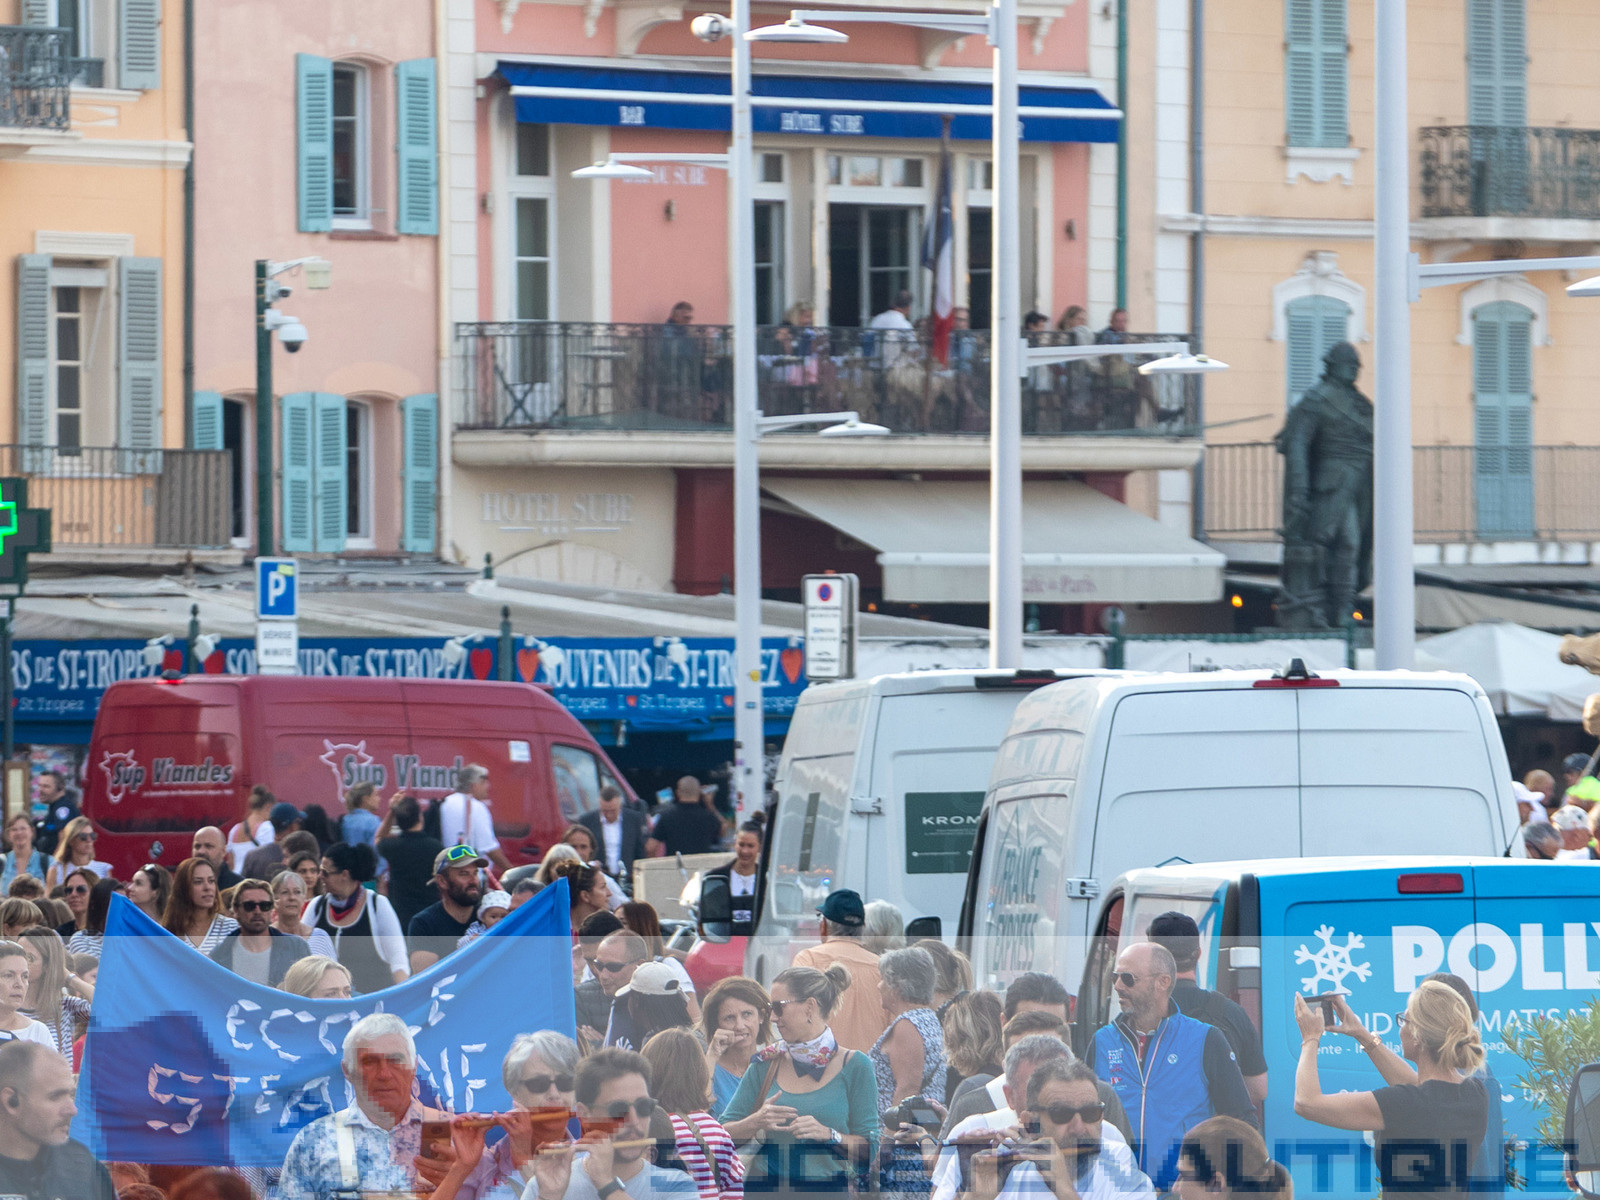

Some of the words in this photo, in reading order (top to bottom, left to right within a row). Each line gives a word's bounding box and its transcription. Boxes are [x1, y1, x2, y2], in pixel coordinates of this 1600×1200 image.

[619, 105, 645, 125] BAR
[571, 492, 634, 523] SUBE
[268, 571, 286, 607] P
[34, 656, 55, 683] DE
[112, 760, 146, 793] Sup
[152, 756, 234, 786] Viandes
[393, 754, 465, 790] Viand
